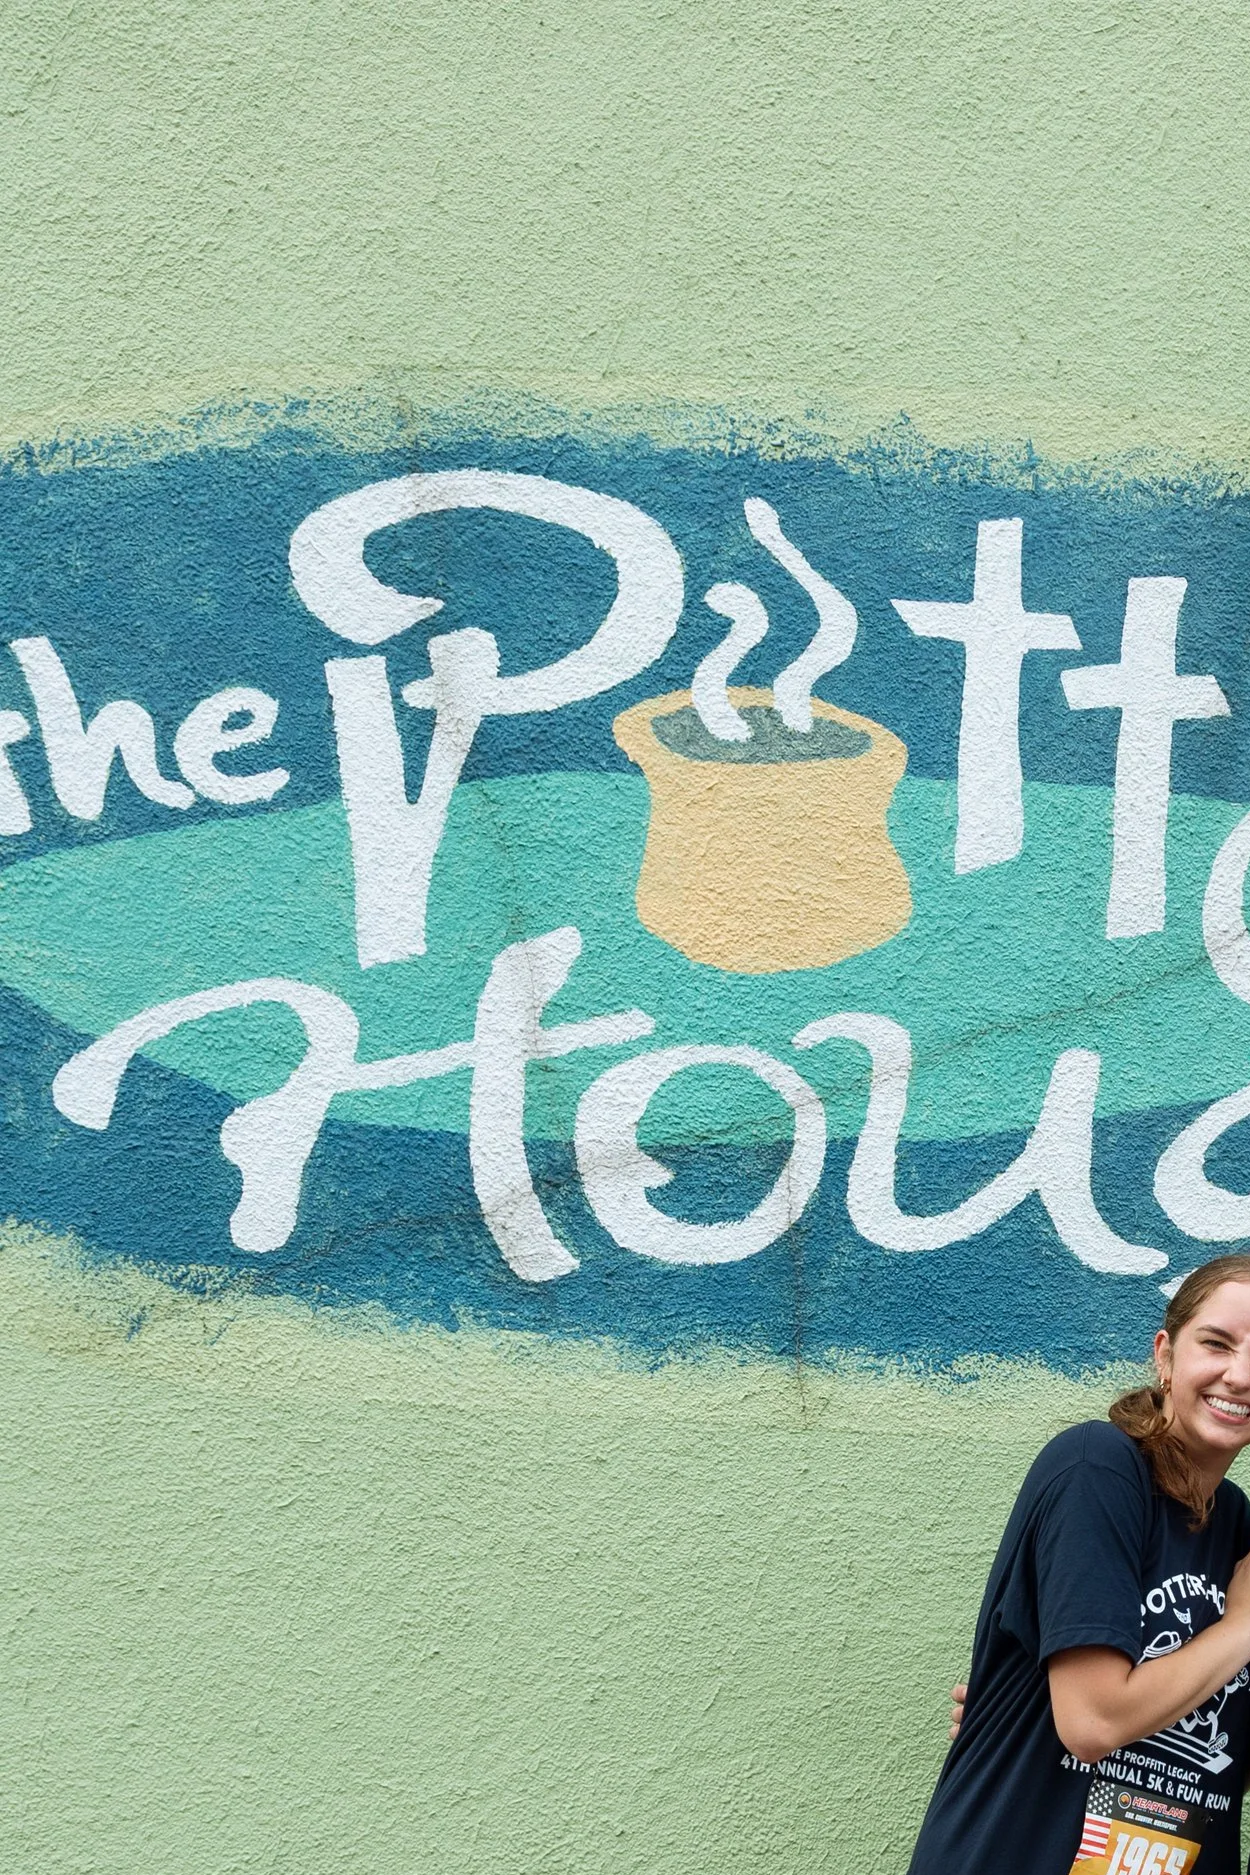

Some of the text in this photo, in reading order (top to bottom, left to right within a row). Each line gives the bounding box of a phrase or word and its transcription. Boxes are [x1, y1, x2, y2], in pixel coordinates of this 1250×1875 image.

[1124, 1751, 1167, 1774] PROFFITT
[1167, 1764, 1202, 1784] LEGACY
[1093, 1760, 1143, 1786] NNUAL
[1146, 1774, 1164, 1793] 5K
[1165, 1781, 1174, 1797] &
[1176, 1784, 1204, 1805] FUN
[1205, 1793, 1231, 1811] RUN
[1132, 1796, 1189, 1820] HEARTLAND
